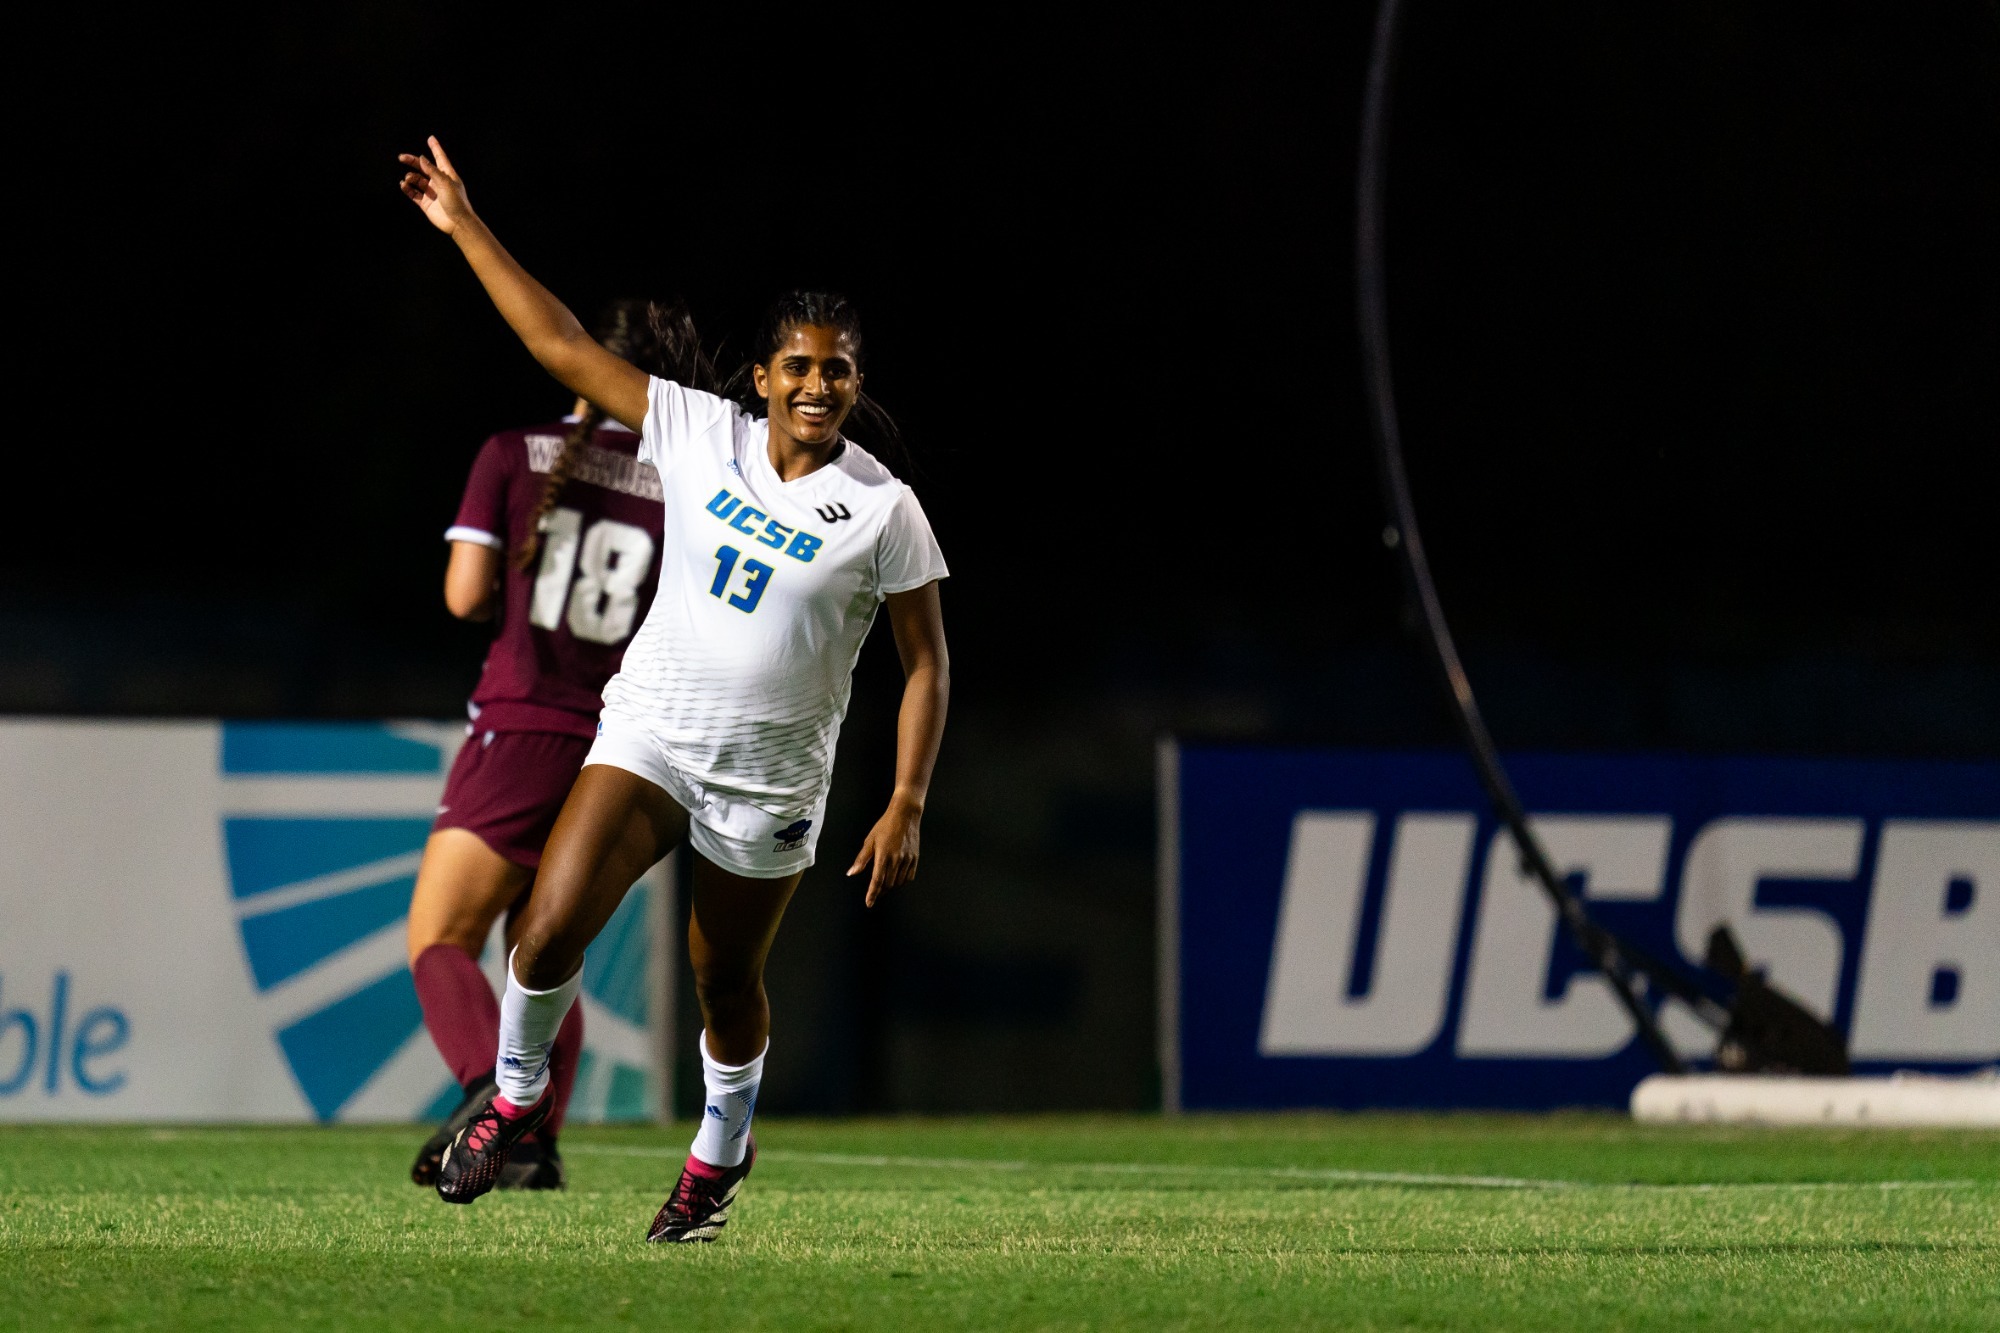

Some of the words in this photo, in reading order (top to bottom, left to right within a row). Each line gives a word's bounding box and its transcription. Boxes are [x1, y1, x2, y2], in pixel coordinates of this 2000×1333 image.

[530, 509, 653, 645] 18
[706, 488, 824, 564] UCSB
[709, 544, 776, 615] 13
[1258, 810, 2000, 1057] UCSB
